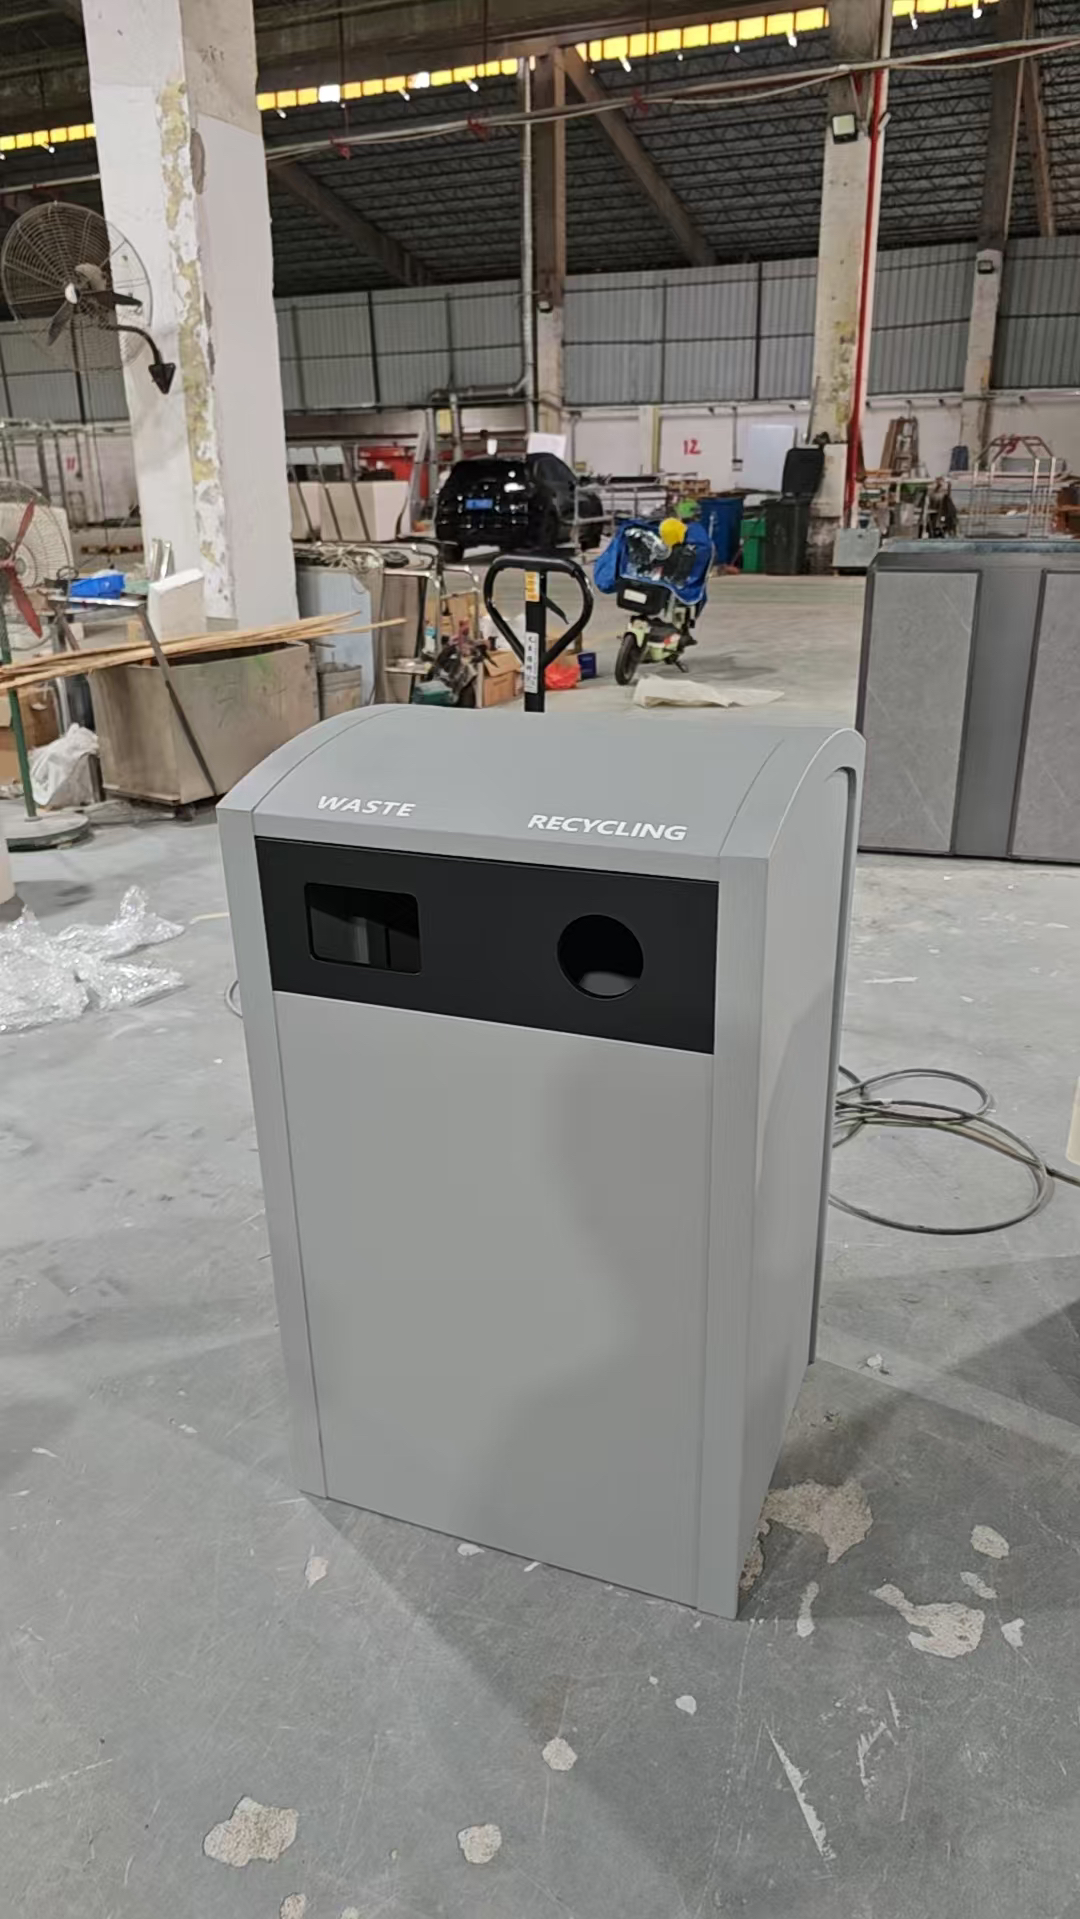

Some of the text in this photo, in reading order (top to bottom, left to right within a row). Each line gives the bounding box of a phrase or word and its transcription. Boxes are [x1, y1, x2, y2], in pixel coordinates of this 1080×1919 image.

[683, 438, 702, 456] 12
[317, 795, 417, 817] WASTE
[527, 814, 689, 841] RECYCLING
